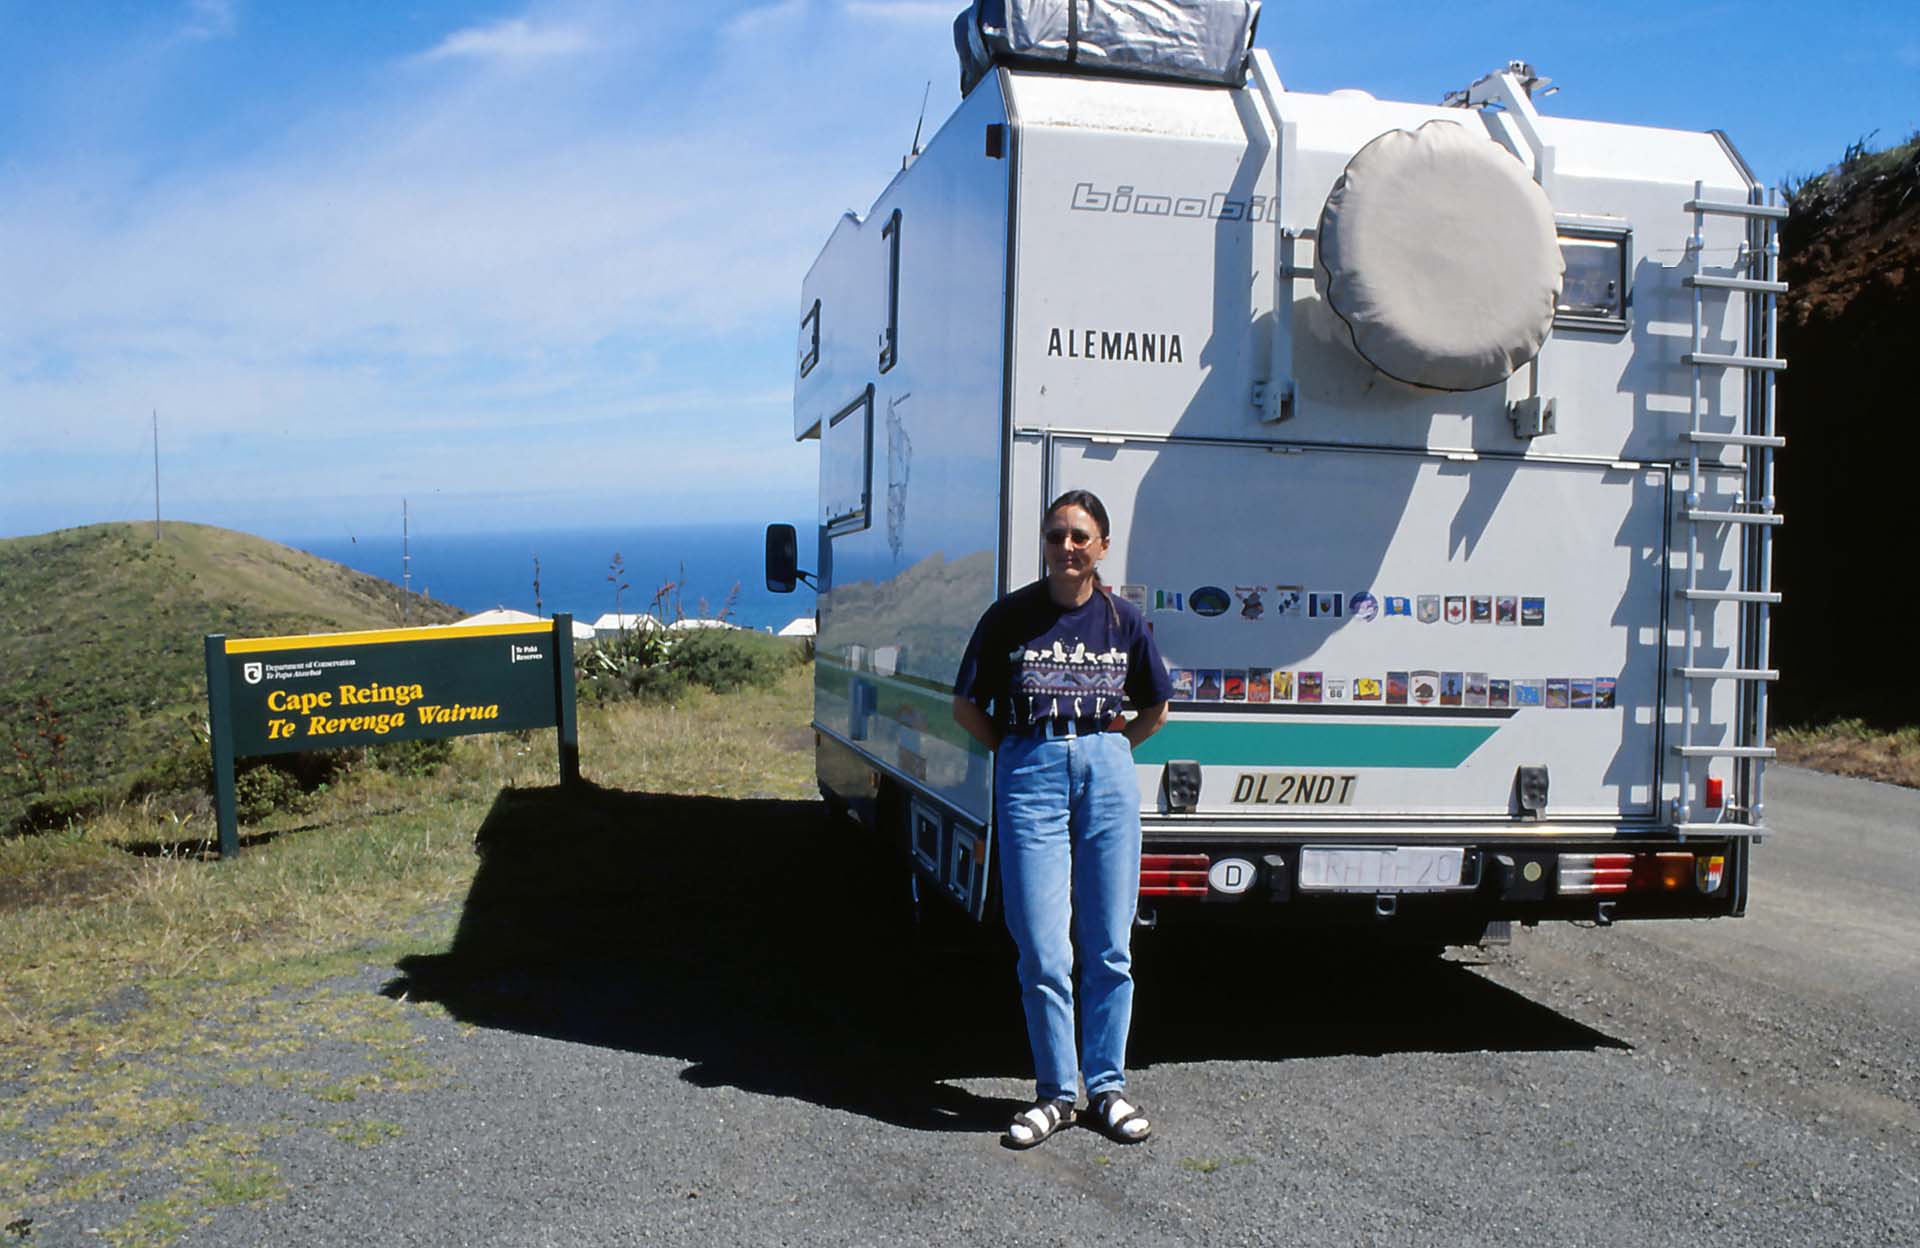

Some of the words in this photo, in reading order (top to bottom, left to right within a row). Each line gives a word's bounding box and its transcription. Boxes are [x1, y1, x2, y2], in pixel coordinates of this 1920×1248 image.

[1071, 183, 1281, 223] bimobil
[1047, 328, 1183, 363] ALEMANIA
[265, 664, 304, 672] Department
[313, 659, 356, 668] Conservation
[267, 690, 332, 715] Cape
[339, 683, 424, 707] Reinga
[267, 718, 296, 739] Te
[307, 710, 406, 735] Rerenga
[418, 703, 499, 725] Wairua
[1233, 775, 1356, 804] DL2NDT
[1225, 864, 1242, 887] D
